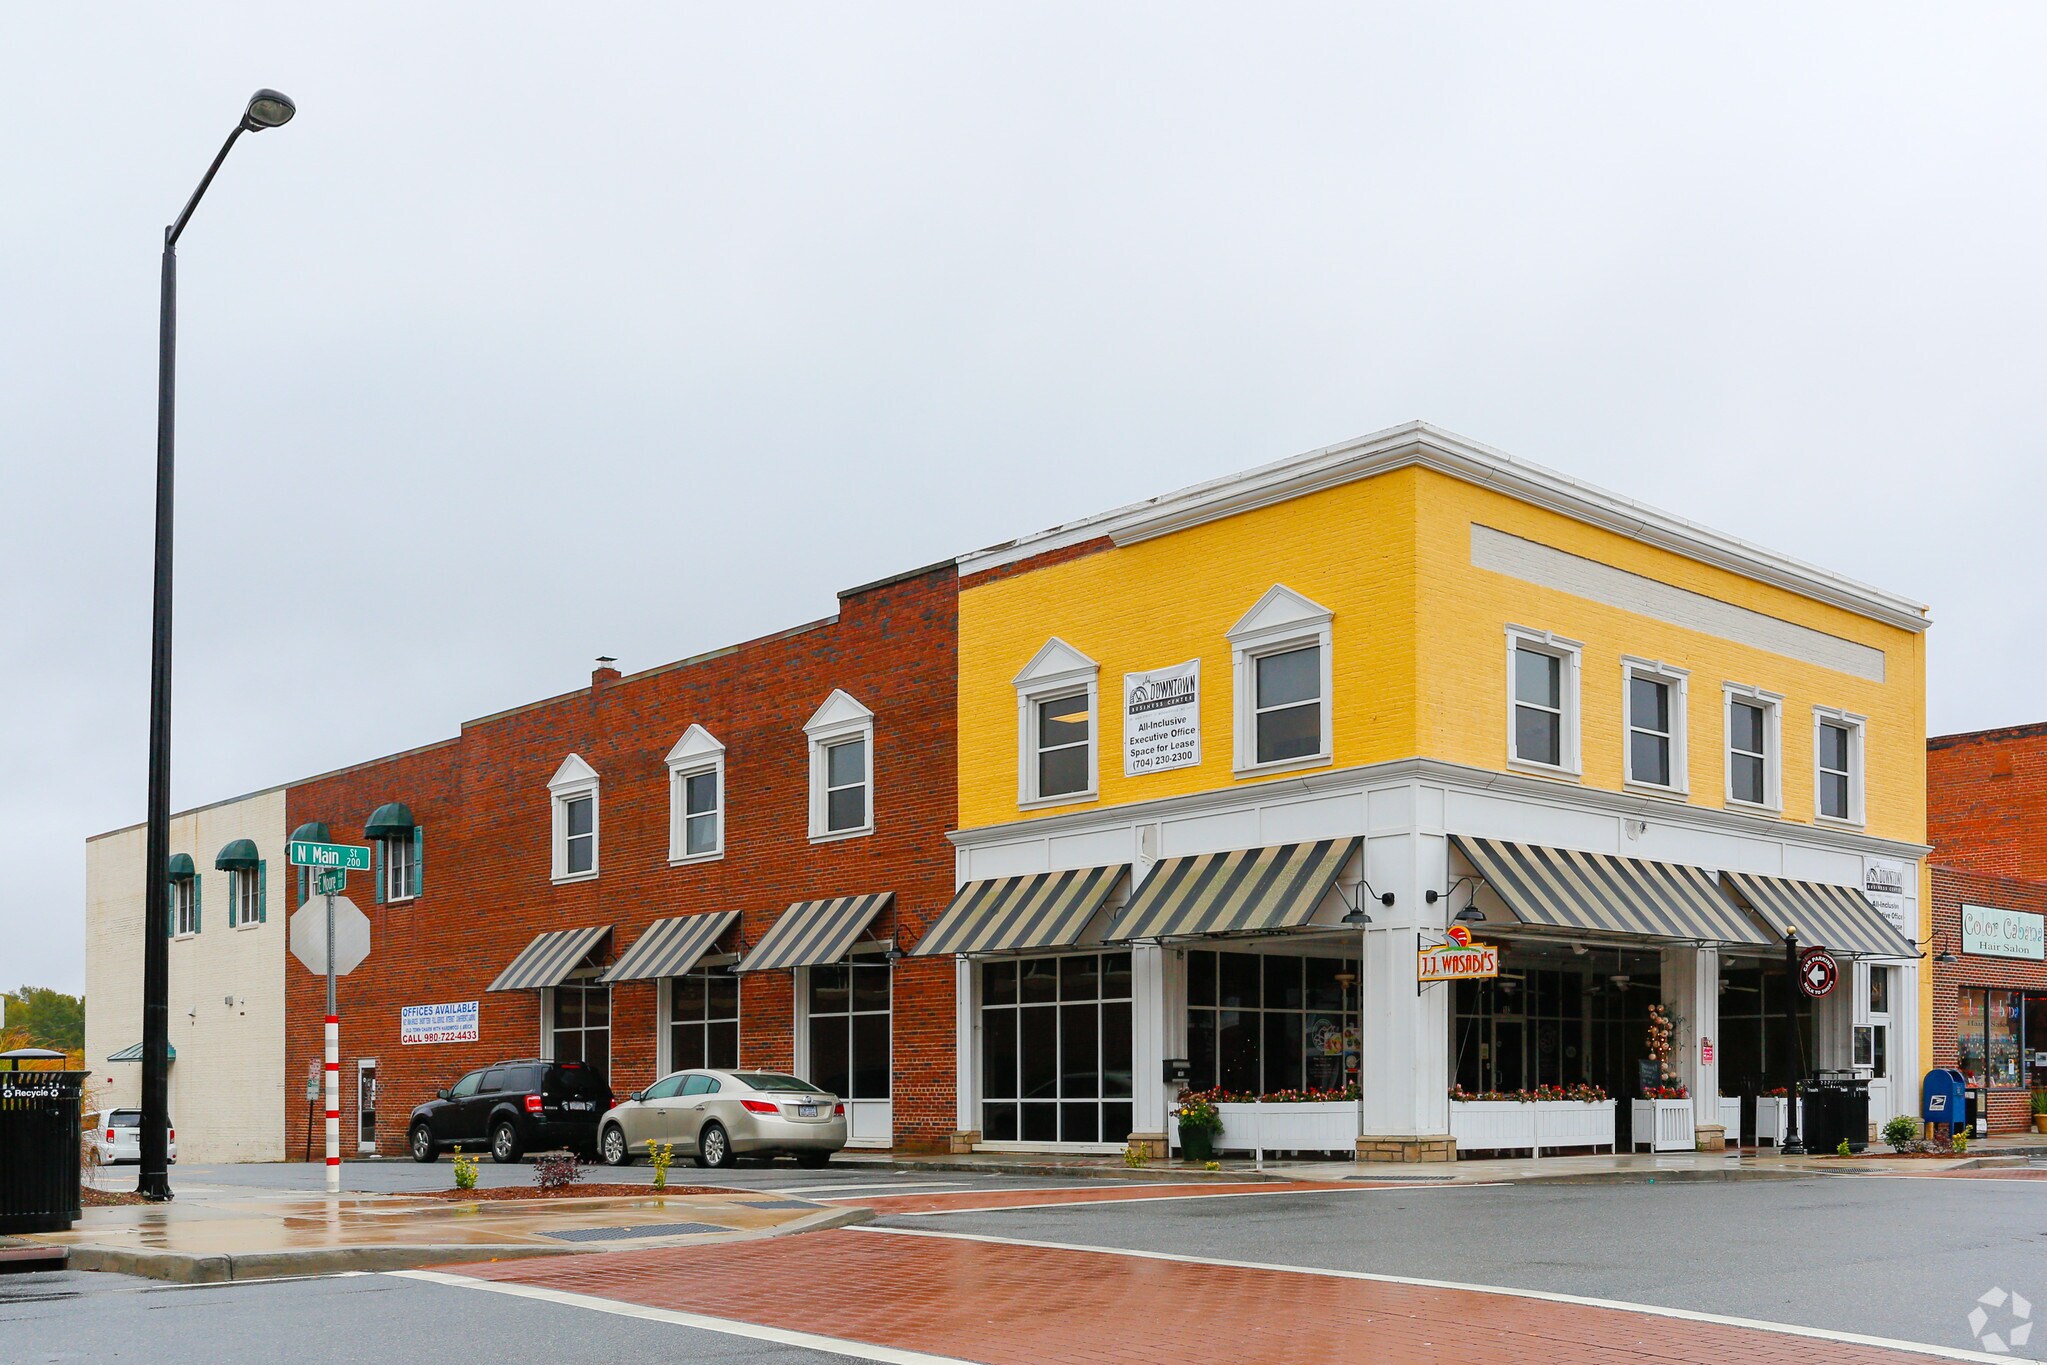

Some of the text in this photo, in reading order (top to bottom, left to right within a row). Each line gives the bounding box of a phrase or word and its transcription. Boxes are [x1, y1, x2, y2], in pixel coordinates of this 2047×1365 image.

[1150, 674, 1196, 701] DOWNTOWN
[1131, 695, 1193, 713] BUSINESS CENTER
[1138, 716, 1187, 732] All-Inclusive
[1129, 727, 1196, 746] Executive Office
[1130, 739, 1195, 758] Space for Lease
[1132, 750, 1193, 770] (704) 230-2300
[297, 845, 358, 865] N Main St
[346, 857, 361, 867] 200
[1964, 912, 2043, 942] Color Cabana
[1979, 941, 2030, 954] Hair Salon
[1422, 951, 1494, 975] J.J. WASABI'S
[1803, 956, 1834, 972] CAR PARKING
[1803, 981, 1815, 994] WALK
[1821, 980, 1834, 994] SHOPS
[402, 1002, 477, 1017] OFFICES AVAILABLE
[402, 1030, 477, 1043] CALL 980-722-4433
[14, 1089, 49, 1098] Recycle
